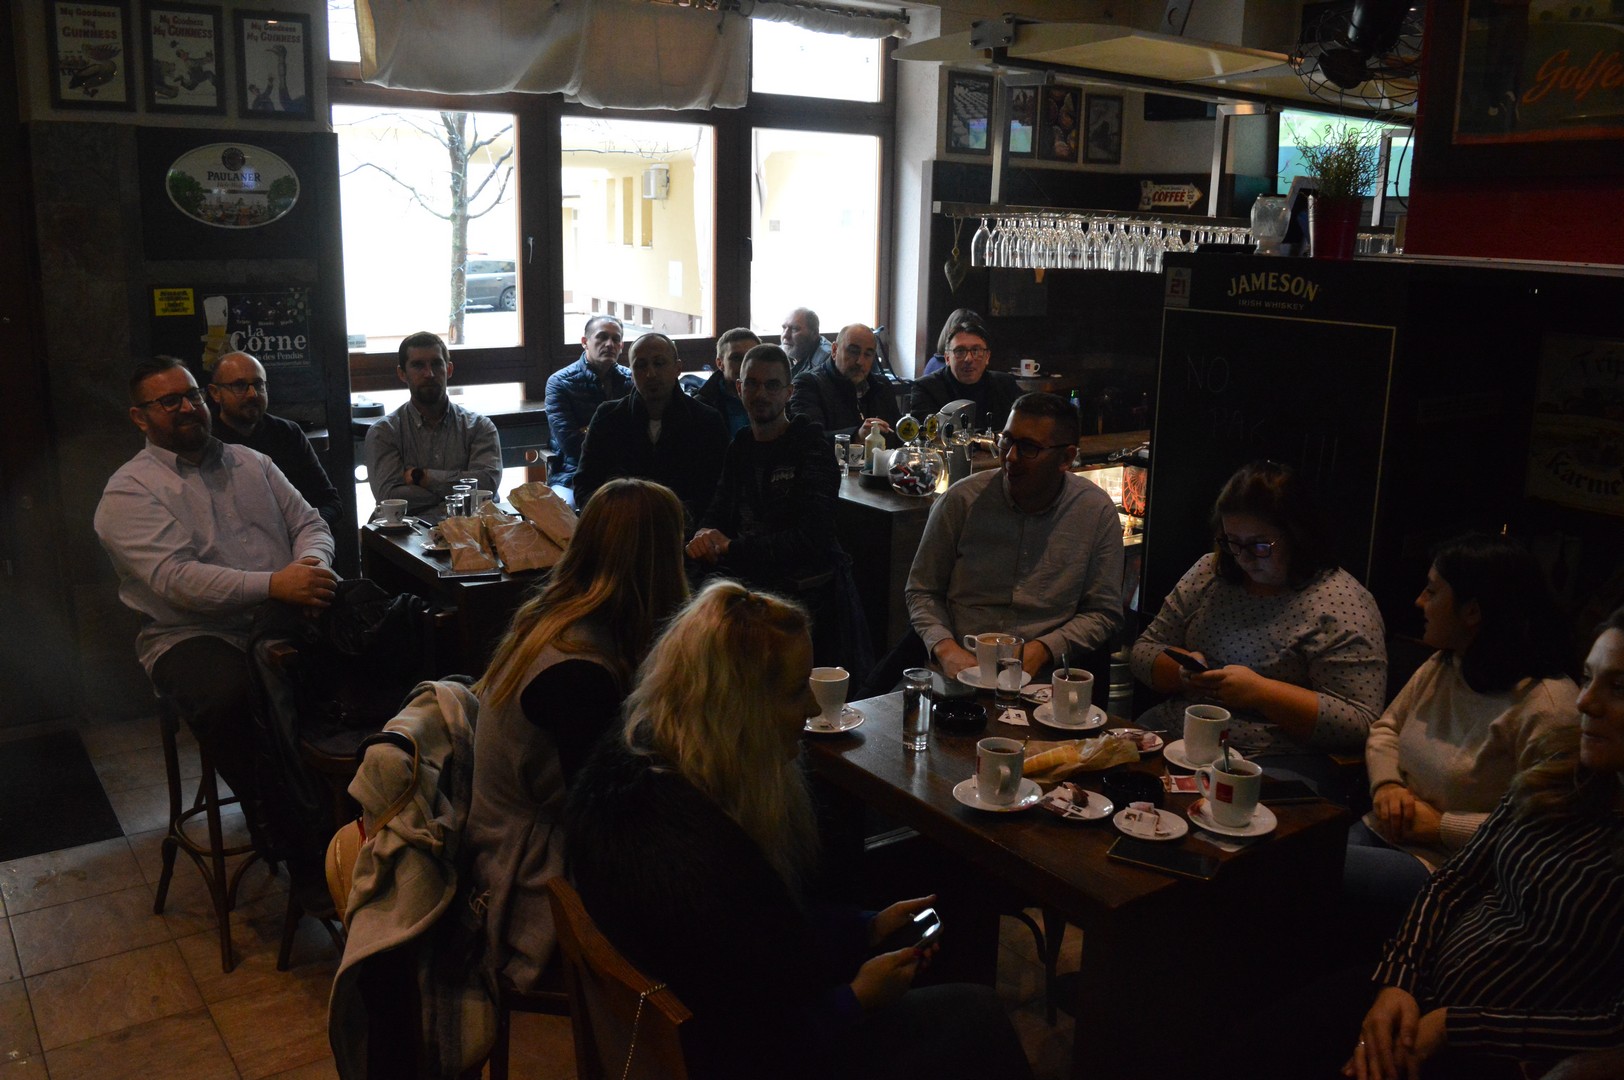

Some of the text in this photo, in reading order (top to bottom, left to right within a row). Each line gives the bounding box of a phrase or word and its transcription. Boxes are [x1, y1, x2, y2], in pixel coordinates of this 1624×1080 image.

[62, 26, 117, 39] GUINNESS
[168, 25, 213, 38] GUINNESS
[260, 31, 301, 43] GUINNESS
[207, 171, 262, 183] PAULANER
[1152, 191, 1187, 202] COFFEE
[1227, 270, 1319, 302] JAMESON
[1239, 298, 1305, 311] IRISH WHISKEY
[248, 325, 264, 337] La
[230, 330, 307, 352] Corne
[263, 353, 275, 361] des
